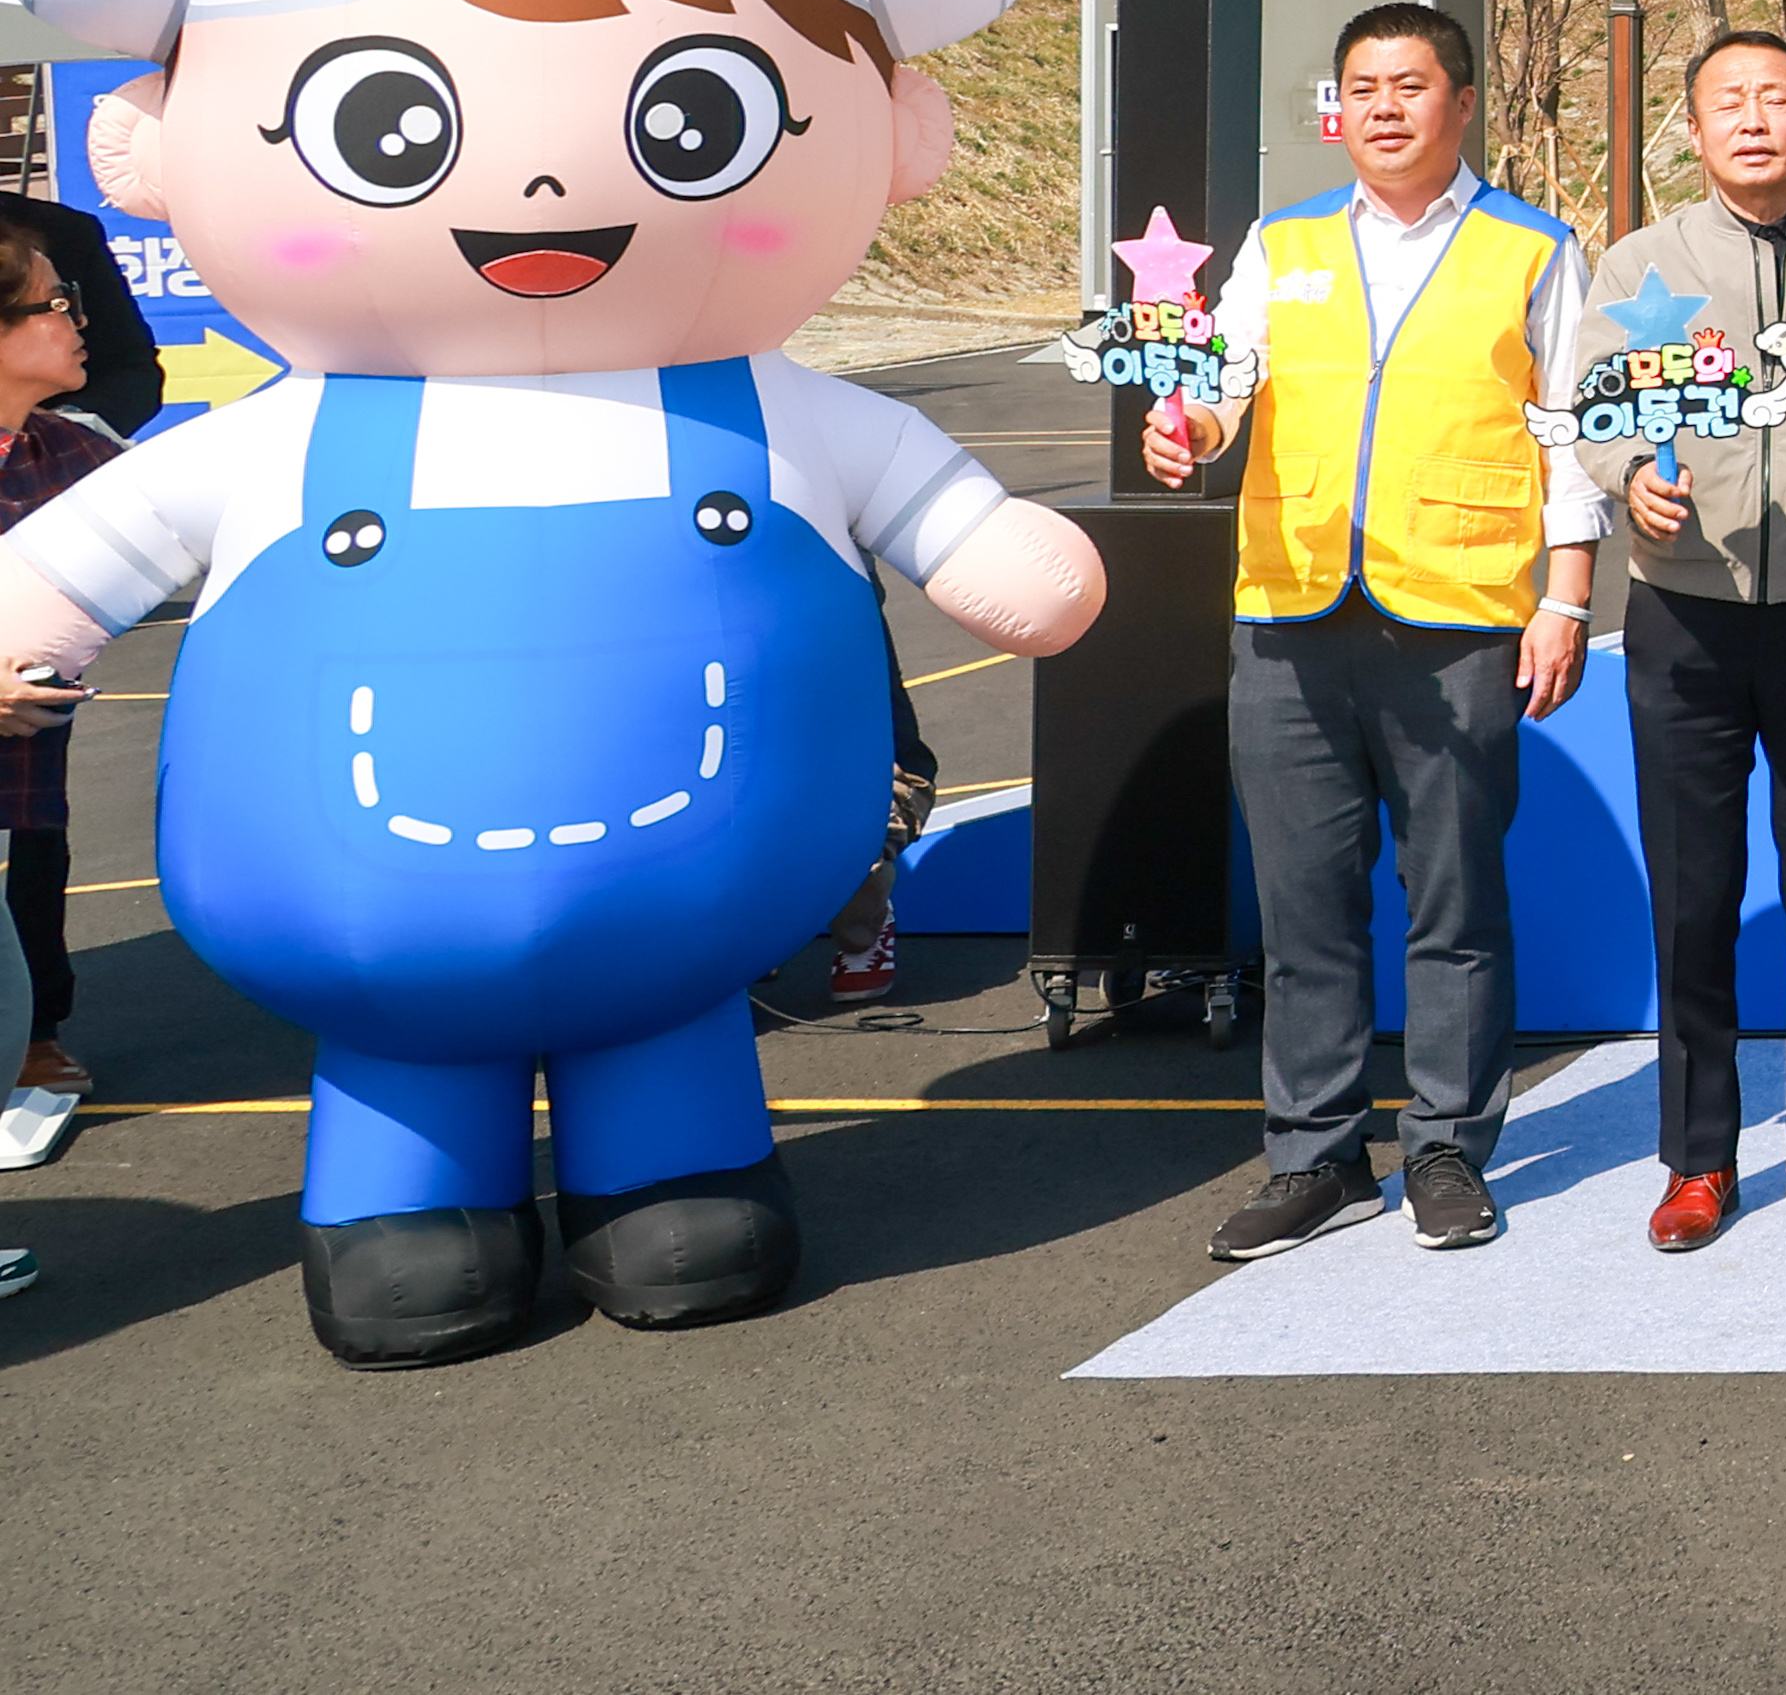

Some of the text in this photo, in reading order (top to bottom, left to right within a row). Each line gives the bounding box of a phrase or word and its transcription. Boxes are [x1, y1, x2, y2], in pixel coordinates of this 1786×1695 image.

[1132, 301, 1213, 344] 모두의
[1102, 342, 1222, 403] 이동권
[1627, 343, 1735, 389] 모두의
[1581, 384, 1741, 443] 이동권
